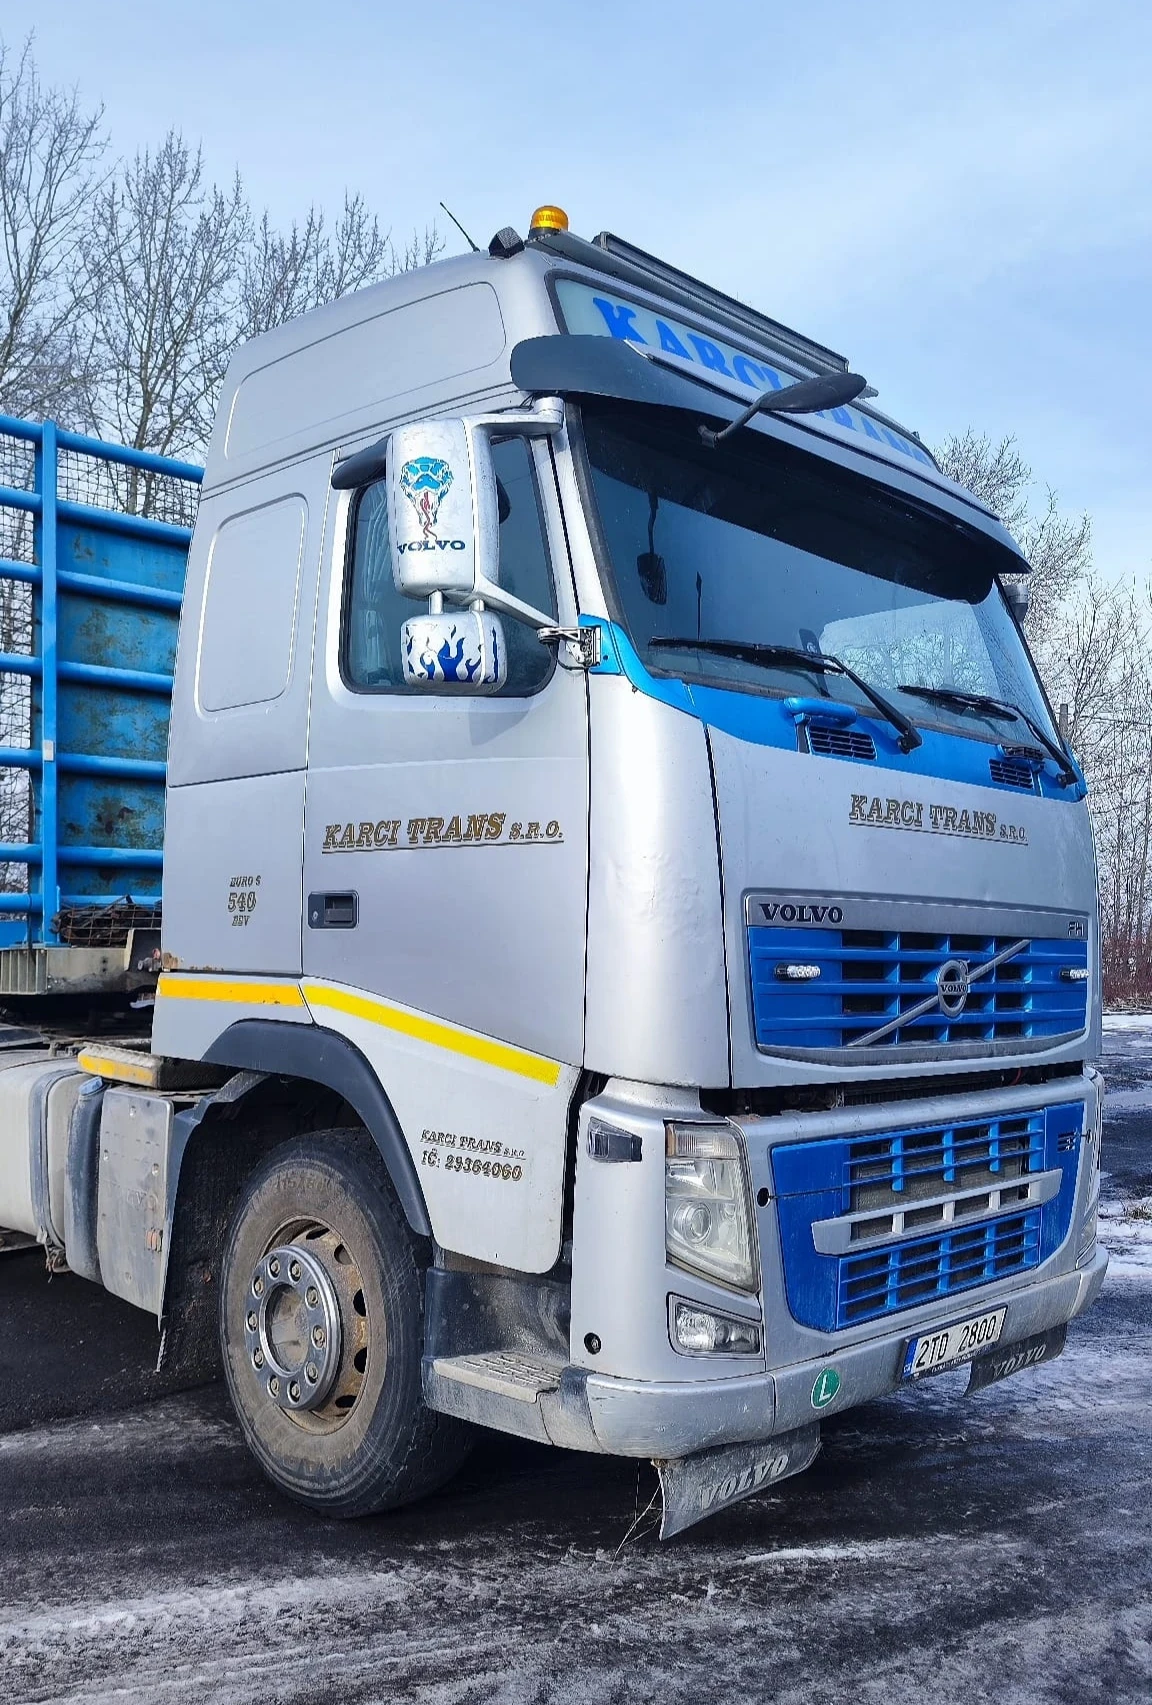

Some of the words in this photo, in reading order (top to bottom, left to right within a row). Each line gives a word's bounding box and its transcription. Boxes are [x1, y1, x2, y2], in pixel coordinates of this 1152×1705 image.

[397, 540, 466, 555] VOLVO
[849, 794, 924, 828] KARCI
[929, 804, 998, 837] TRANS
[323, 820, 402, 850] KARCI
[407, 812, 507, 844] TRANS
[229, 876, 254, 888] EURO
[227, 891, 257, 913] 540
[759, 903, 844, 924] VOLVO
[940, 984, 968, 993] VOLVO
[421, 1129, 458, 1146] KARCI
[459, 1136, 504, 1154] TRANS
[445, 1154, 523, 1181] 29364060
[915, 1332, 950, 1369] 2TD
[956, 1314, 998, 1353] 2800
[992, 1343, 1047, 1381] VOLVO
[818, 1368, 832, 1402] L
[700, 1453, 790, 1511] VOLVO
